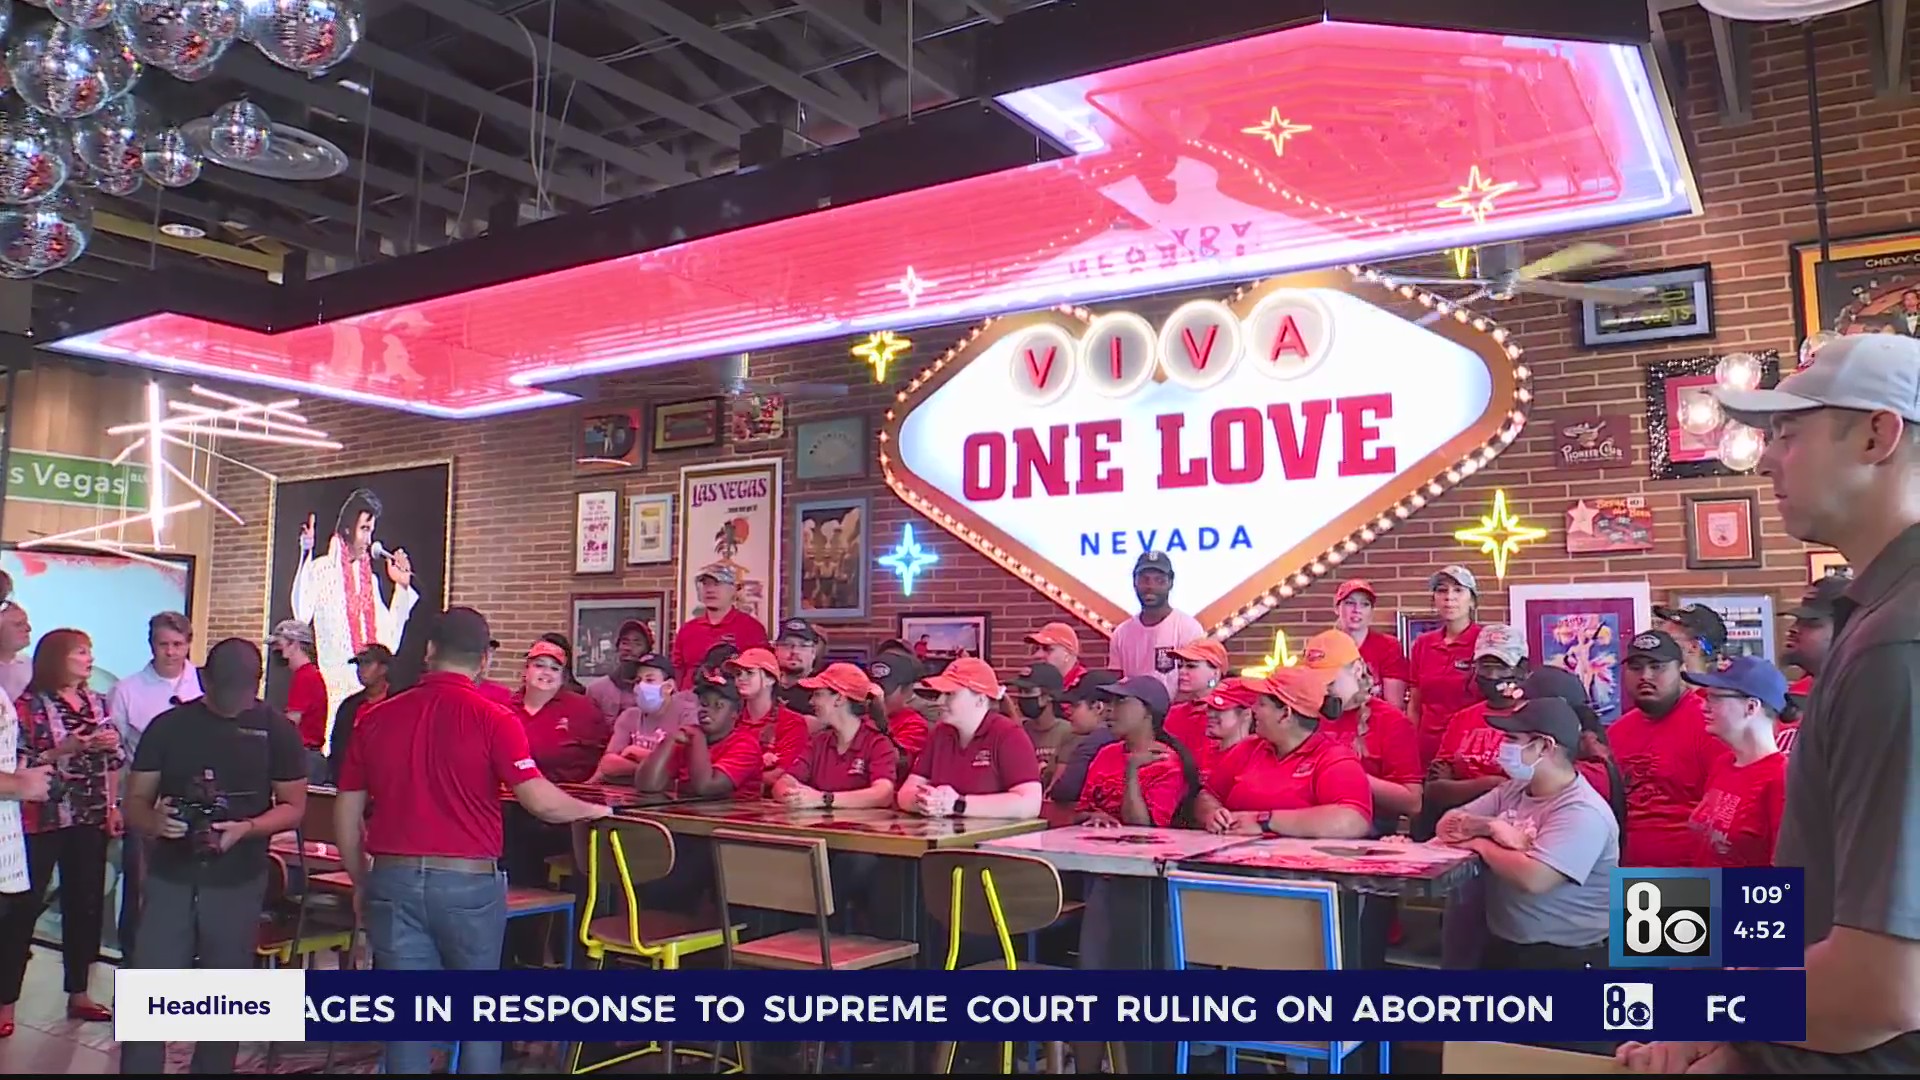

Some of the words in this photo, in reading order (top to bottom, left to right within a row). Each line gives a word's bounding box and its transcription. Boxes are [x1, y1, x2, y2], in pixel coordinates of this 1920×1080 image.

[1864, 255, 1911, 268] CHEVY
[1026, 315, 1310, 390] VIVA
[962, 418, 1124, 502] ONE
[1156, 393, 1397, 490] LOVE
[32, 462, 125, 498] Vegas
[1080, 525, 1253, 556] NEVADA
